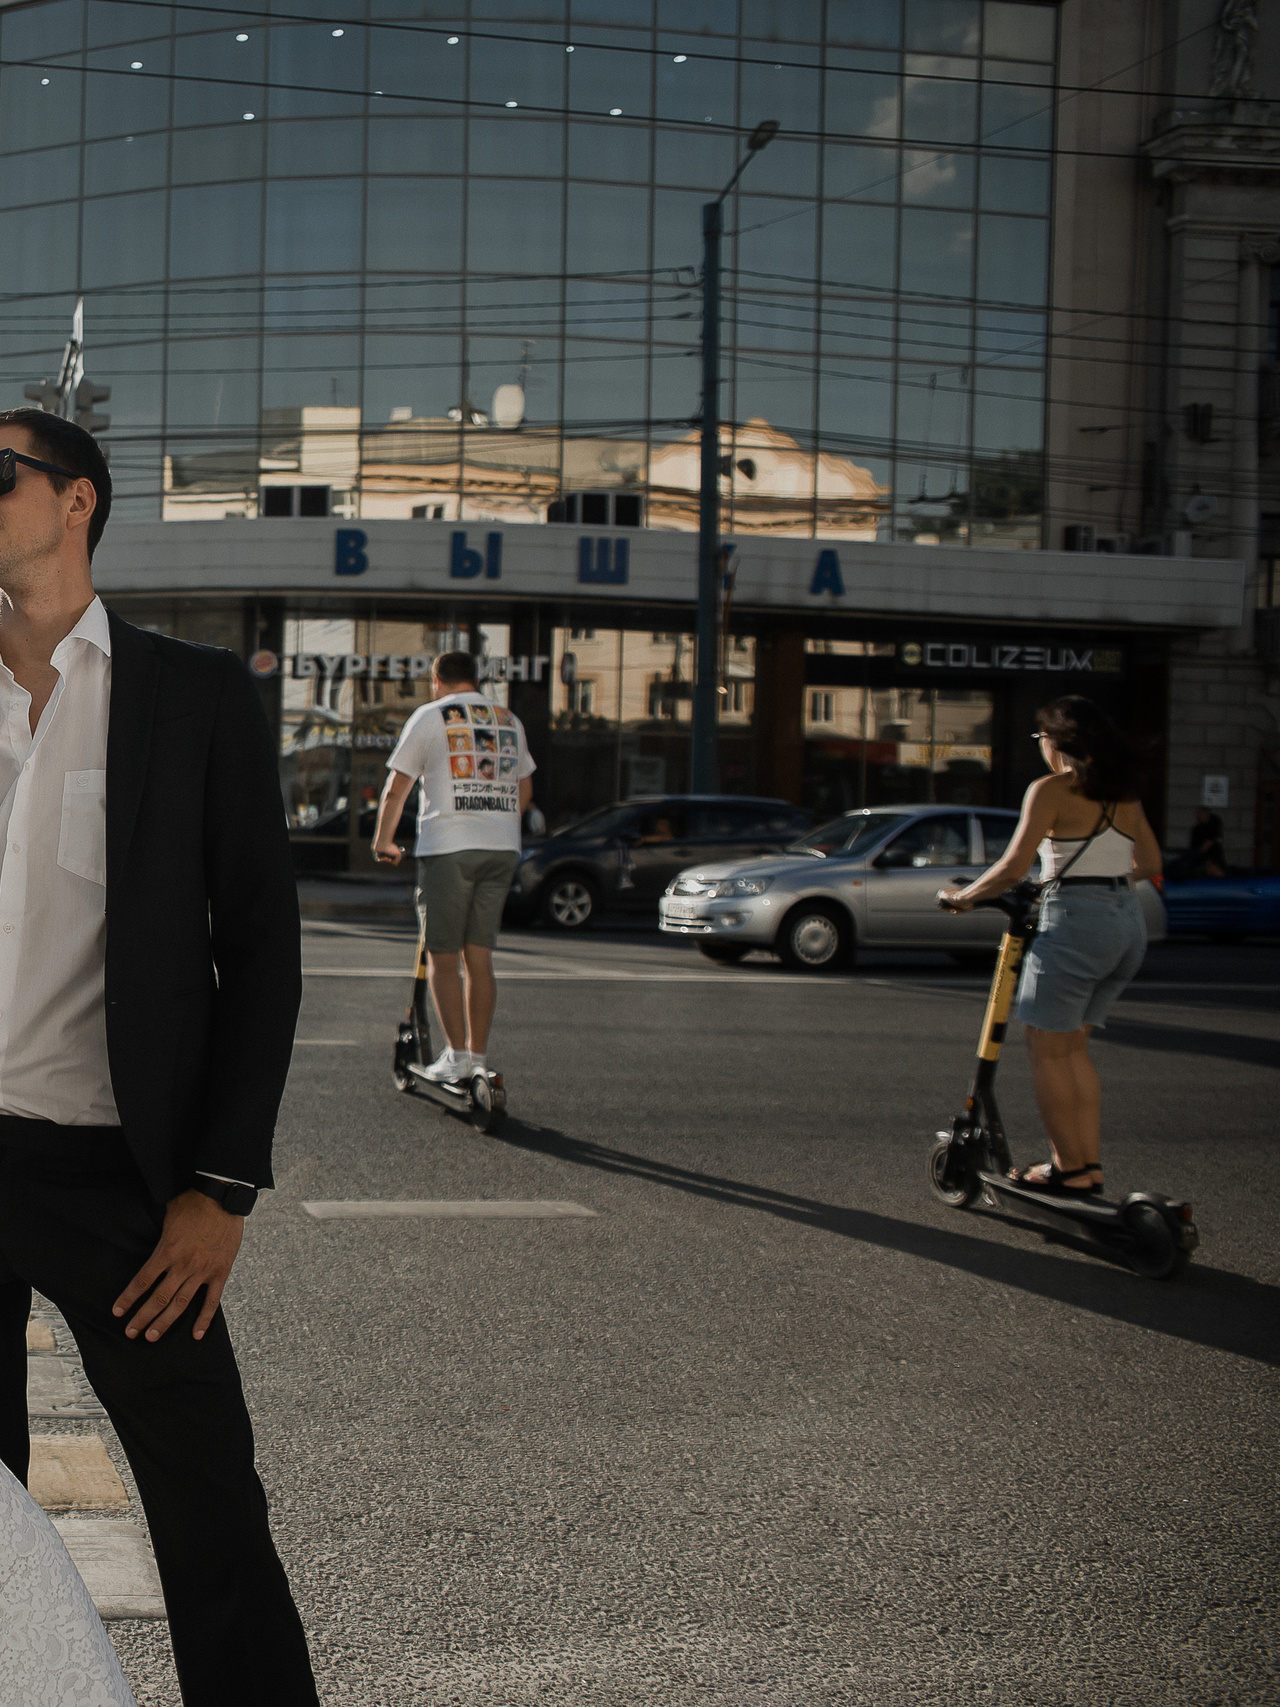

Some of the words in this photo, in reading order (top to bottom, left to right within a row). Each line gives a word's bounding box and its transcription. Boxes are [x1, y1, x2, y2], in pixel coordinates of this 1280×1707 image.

[335, 528, 844, 597] ВЫША
[295, 652, 433, 680] БУРГЕР
[475, 655, 550, 682] ИНГ
